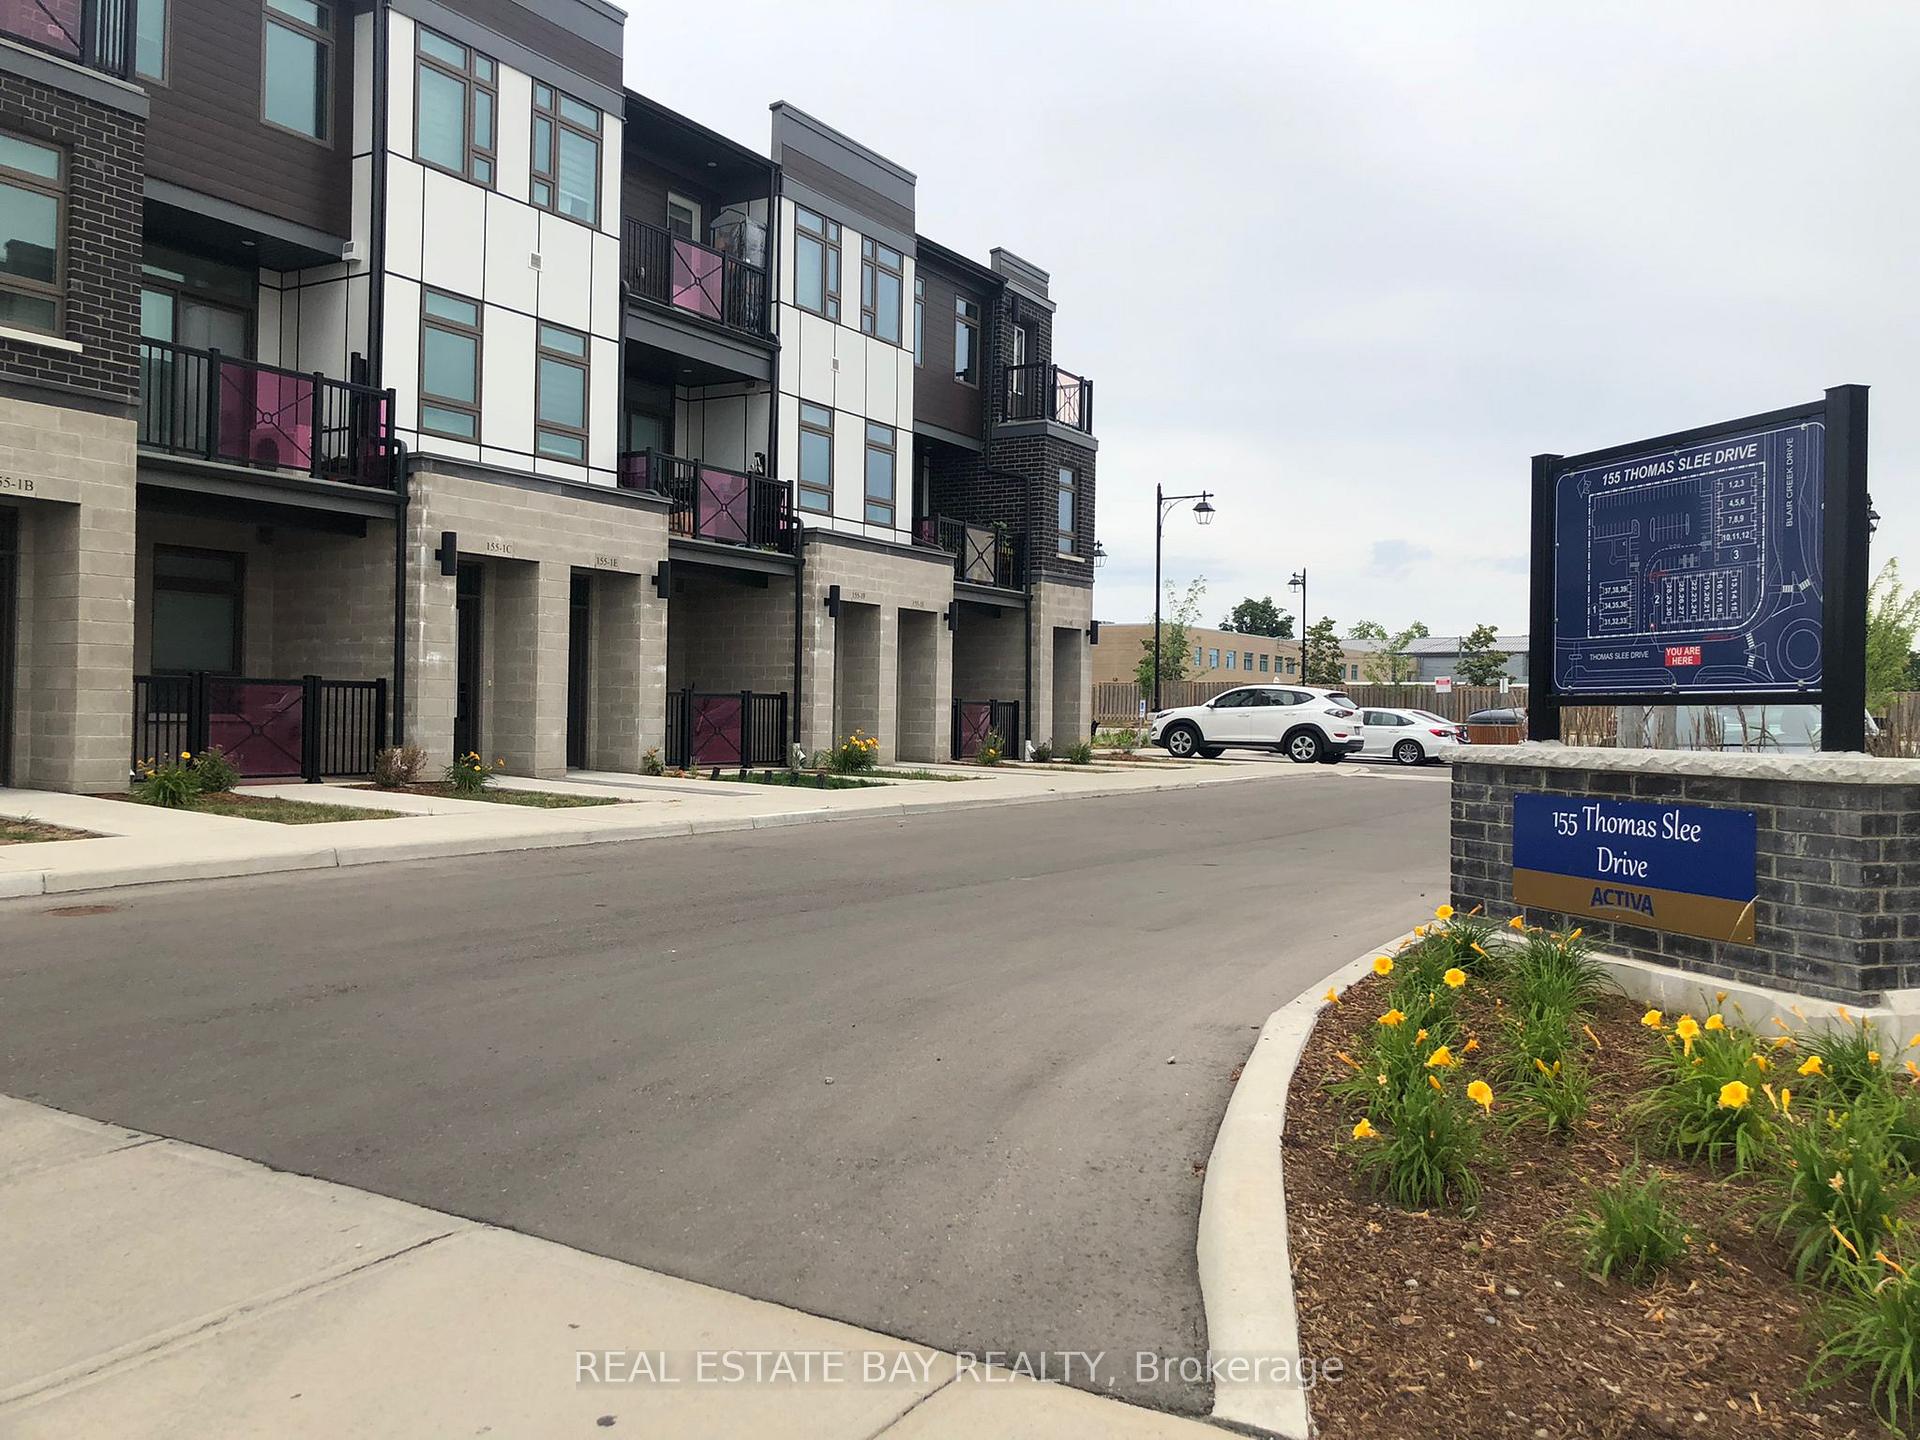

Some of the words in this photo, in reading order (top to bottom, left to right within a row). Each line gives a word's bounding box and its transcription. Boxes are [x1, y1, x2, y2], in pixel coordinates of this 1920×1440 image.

[1786, 437, 1794, 465] DRIVE
[1602, 471, 1621, 486] 155
[1624, 460, 1675, 482] THOMAS
[1678, 452, 1712, 471] SLEE
[1715, 443, 1757, 464] DRIVE
[1729, 479, 1744, 488] 1,2,3
[1728, 498, 1745, 506] 4,5,6
[1728, 514, 1744, 524] 7,8,9
[486, 542, 512, 553] 155-1C
[1733, 549, 1739, 559] 3
[1654, 595, 1660, 604] 2
[1590, 652, 1613, 660] THOMAS
[1630, 651, 1649, 659] DRIVE
[1665, 647, 1682, 656] YOU
[1684, 646, 1700, 655] ARE
[1672, 656, 1693, 665] HERE
[1552, 812, 1578, 836] 155
[1582, 803, 1657, 838] Thomas
[1662, 809, 1701, 842] Slee
[1596, 846, 1648, 878] Drive
[1590, 887, 1654, 917] ACTIVA
